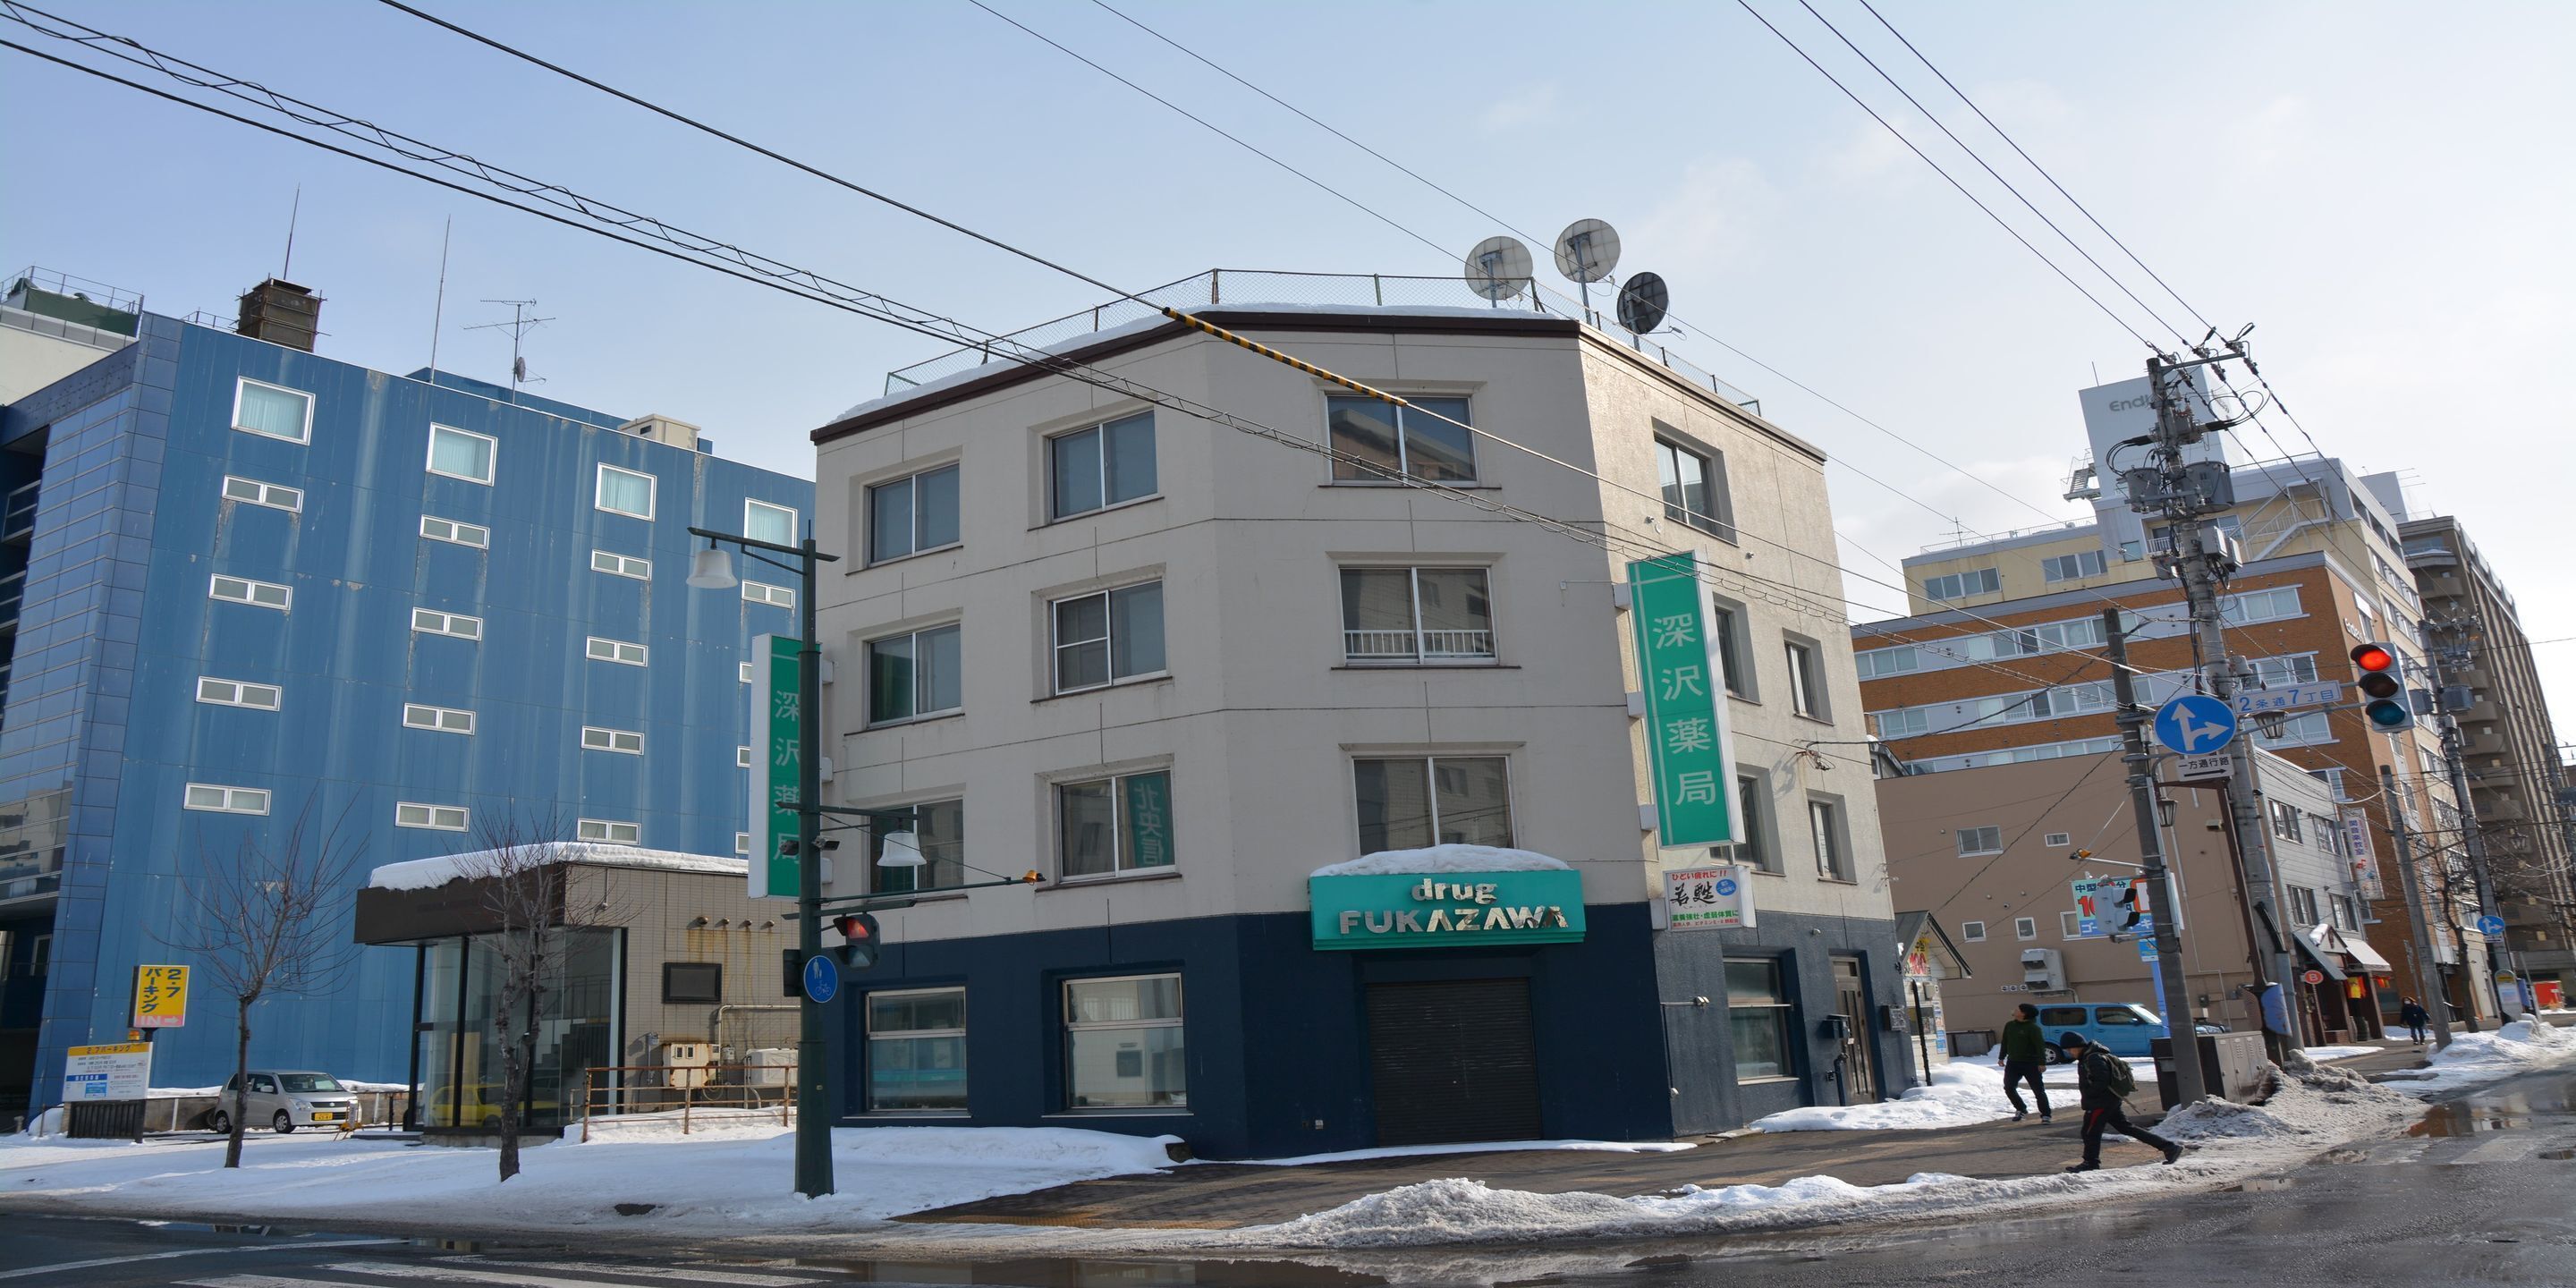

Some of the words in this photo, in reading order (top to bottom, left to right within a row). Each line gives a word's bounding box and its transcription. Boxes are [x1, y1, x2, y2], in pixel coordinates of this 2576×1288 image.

[1653, 612, 1716, 805] 深沢薬局
[2239, 690, 2334, 712] 2条通7丁目
[2178, 757, 2230, 770] 一方通行路
[1411, 878, 1497, 905] drug
[1338, 905, 1569, 934] FUKAZAWA
[141, 969, 162, 1013] パーキング
[140, 1015, 160, 1026] IN
